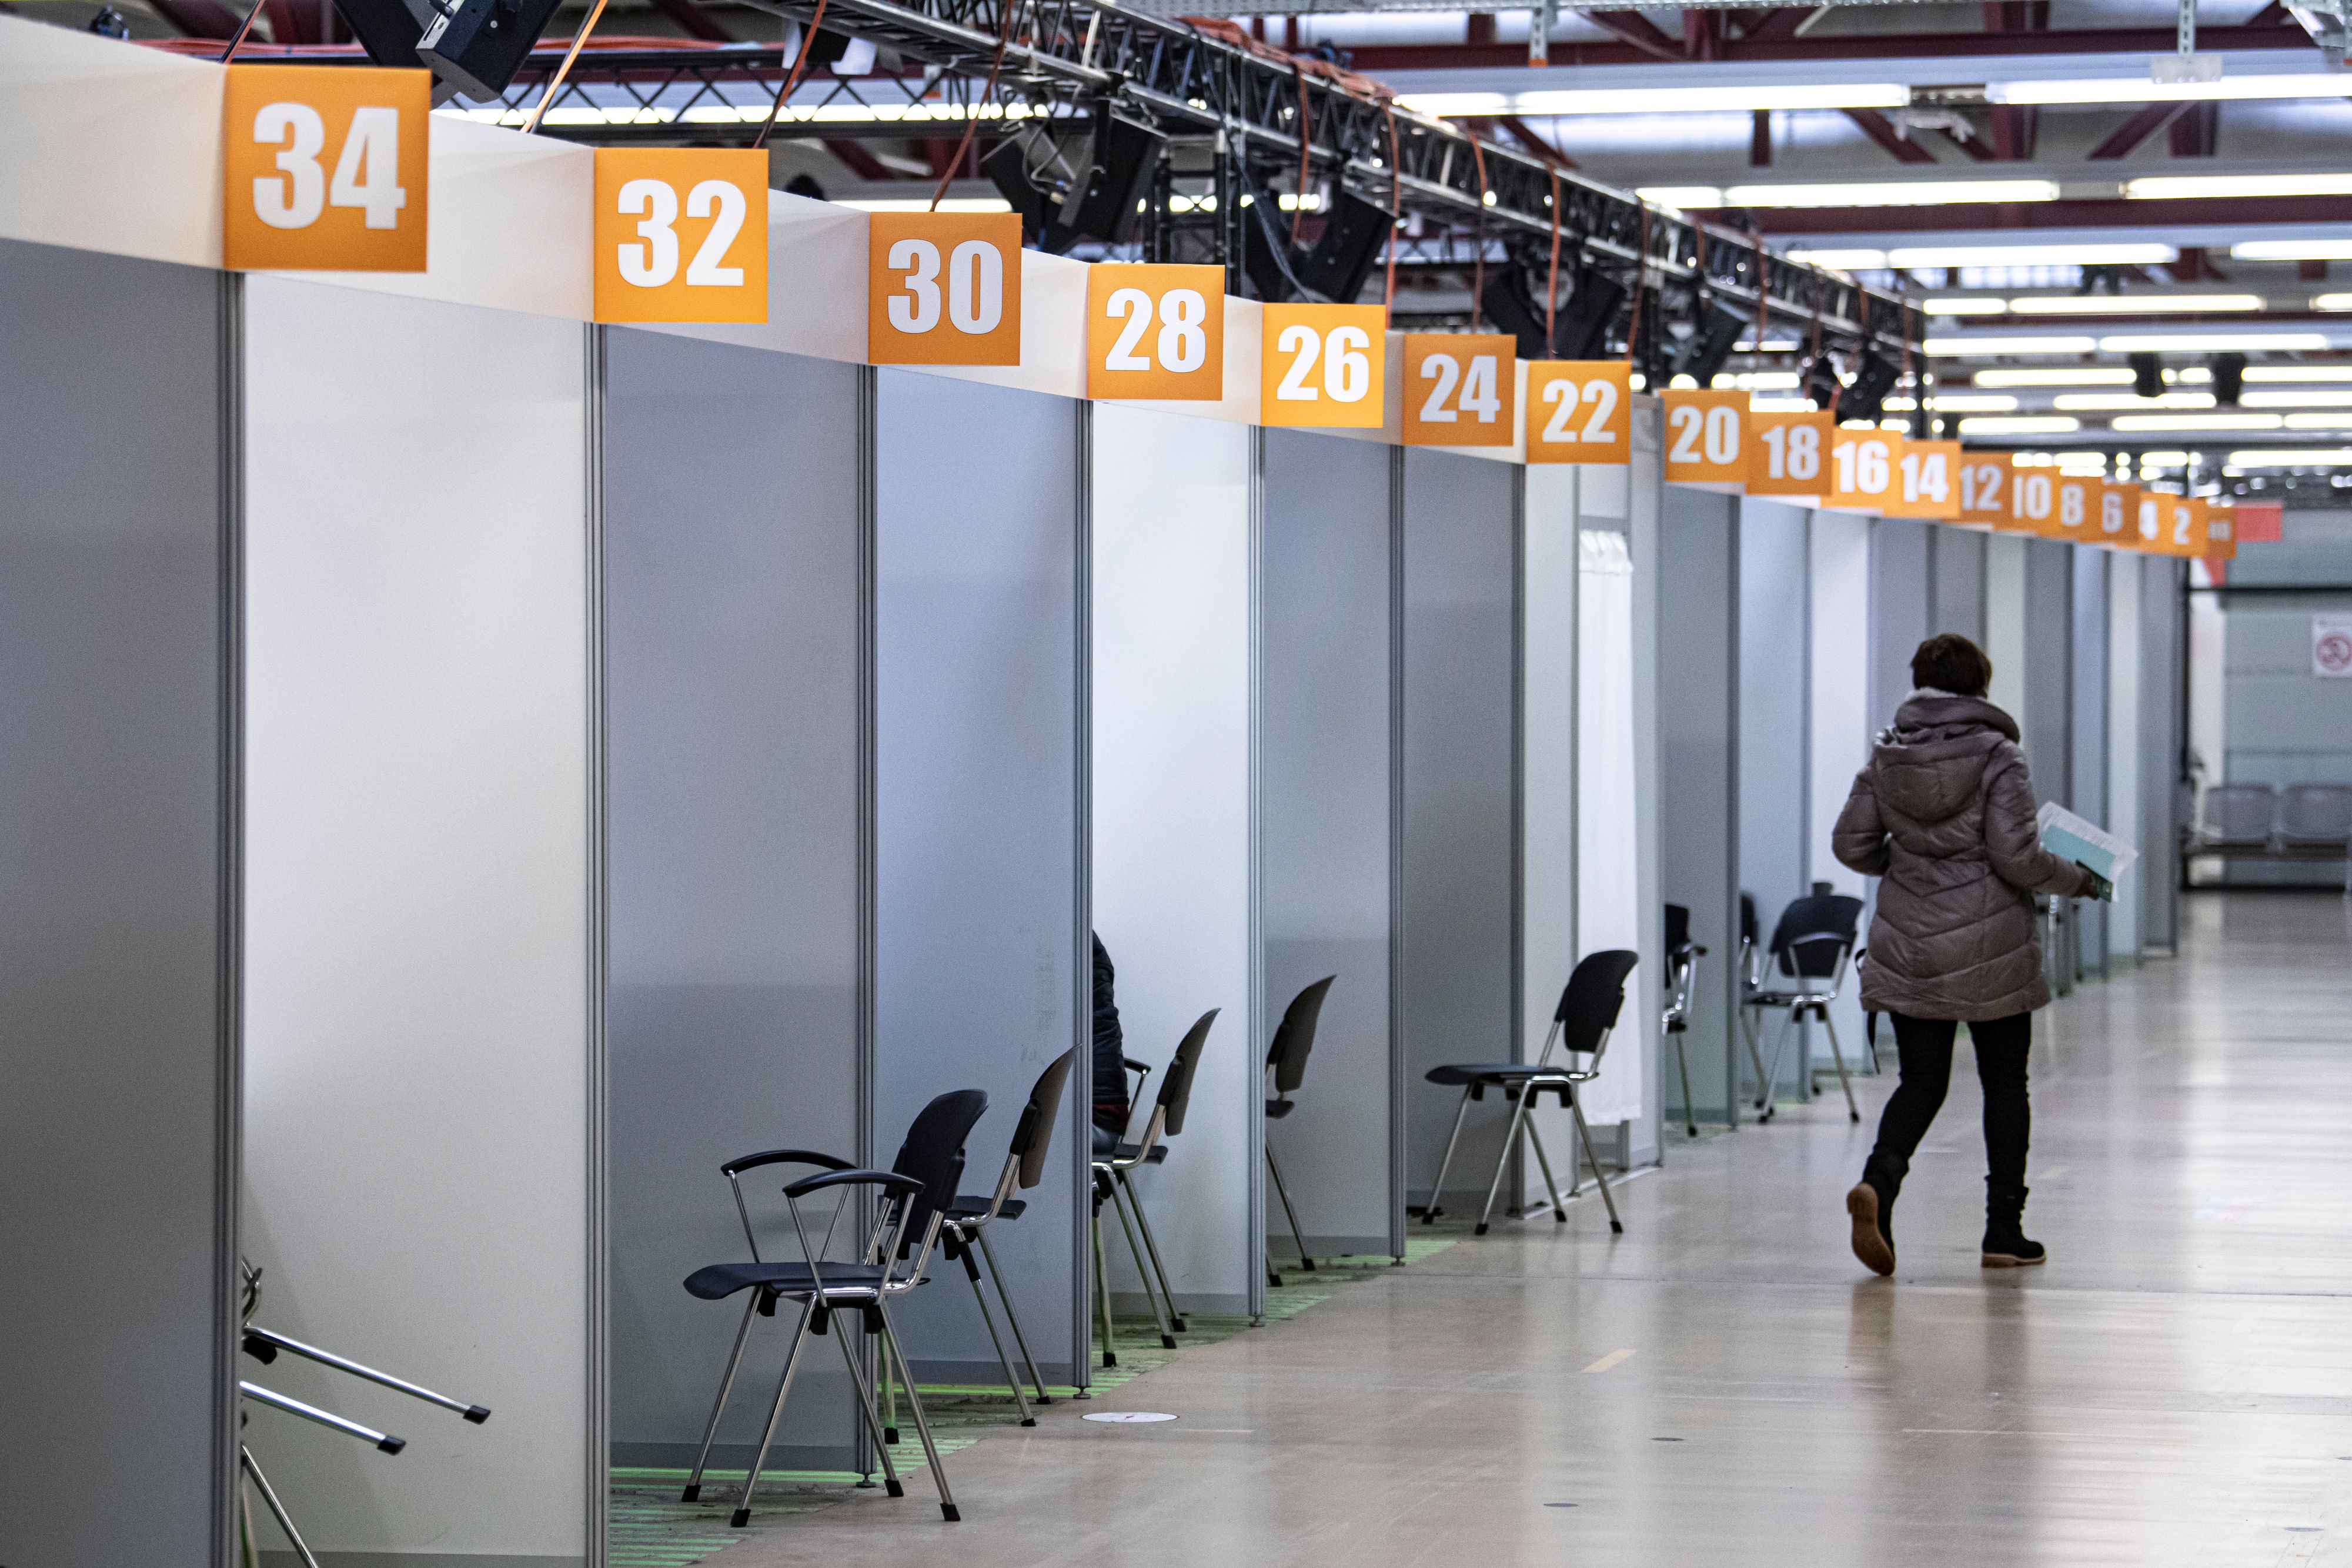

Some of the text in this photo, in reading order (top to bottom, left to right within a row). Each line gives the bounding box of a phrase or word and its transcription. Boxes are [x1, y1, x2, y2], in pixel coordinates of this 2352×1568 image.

[252, 101, 406, 229] 34
[617, 178, 747, 287] 32
[887, 239, 1003, 335] 30
[1105, 287, 1207, 373] 28
[1276, 325, 1371, 403] 26
[1419, 353, 1501, 423] 24
[1542, 378, 1618, 443] 22
[1669, 405, 1740, 465] 20
[1760, 424, 1820, 480] 18
[1833, 440, 1889, 493] 16
[1900, 453, 1949, 503] 14
[1961, 464, 2004, 511] 12
[2013, 474, 2052, 520] 10
[2060, 483, 2085, 527] 8
[2102, 492, 2123, 533] 6
[2173, 506, 2190, 544] 2
